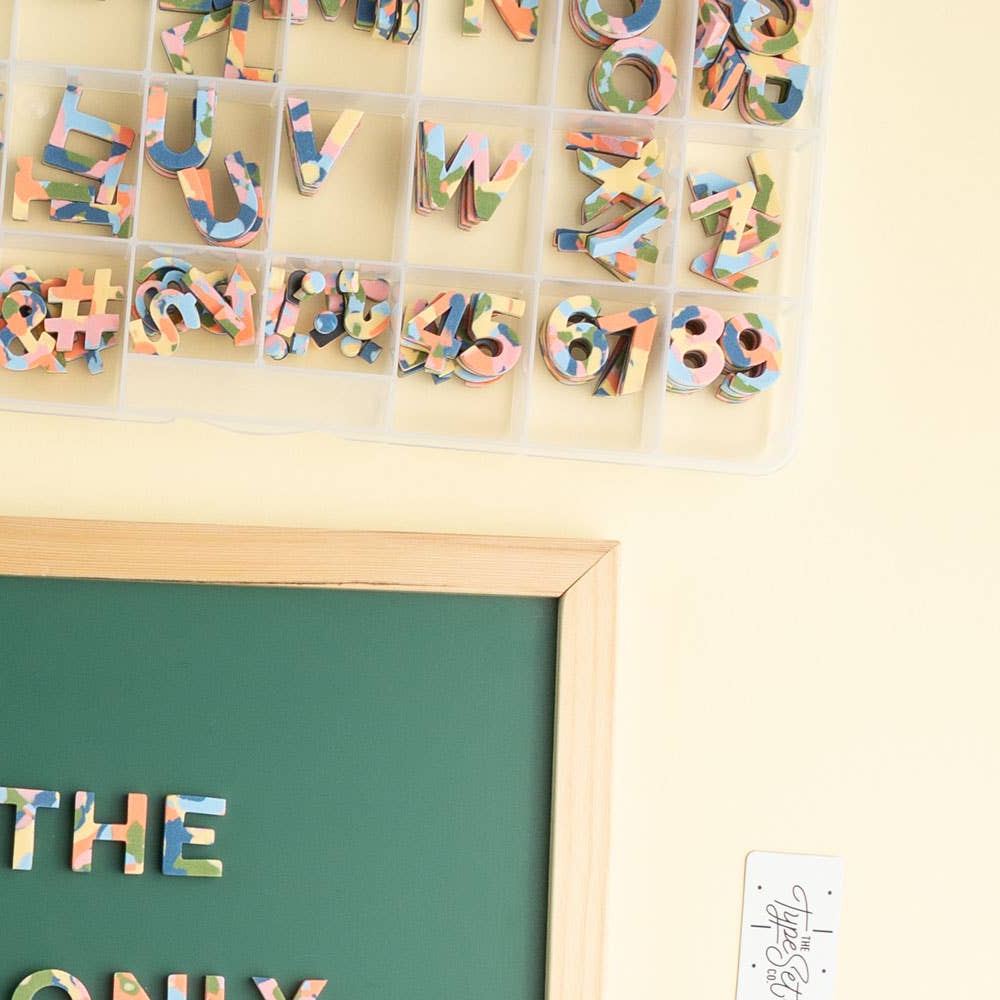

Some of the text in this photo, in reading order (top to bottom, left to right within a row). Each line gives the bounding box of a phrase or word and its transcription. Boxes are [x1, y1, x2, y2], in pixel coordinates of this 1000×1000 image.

[145, 80, 216, 173] U
[286, 97, 364, 194] V
[416, 120, 533, 226] W
[800, 935, 811, 952] THE
